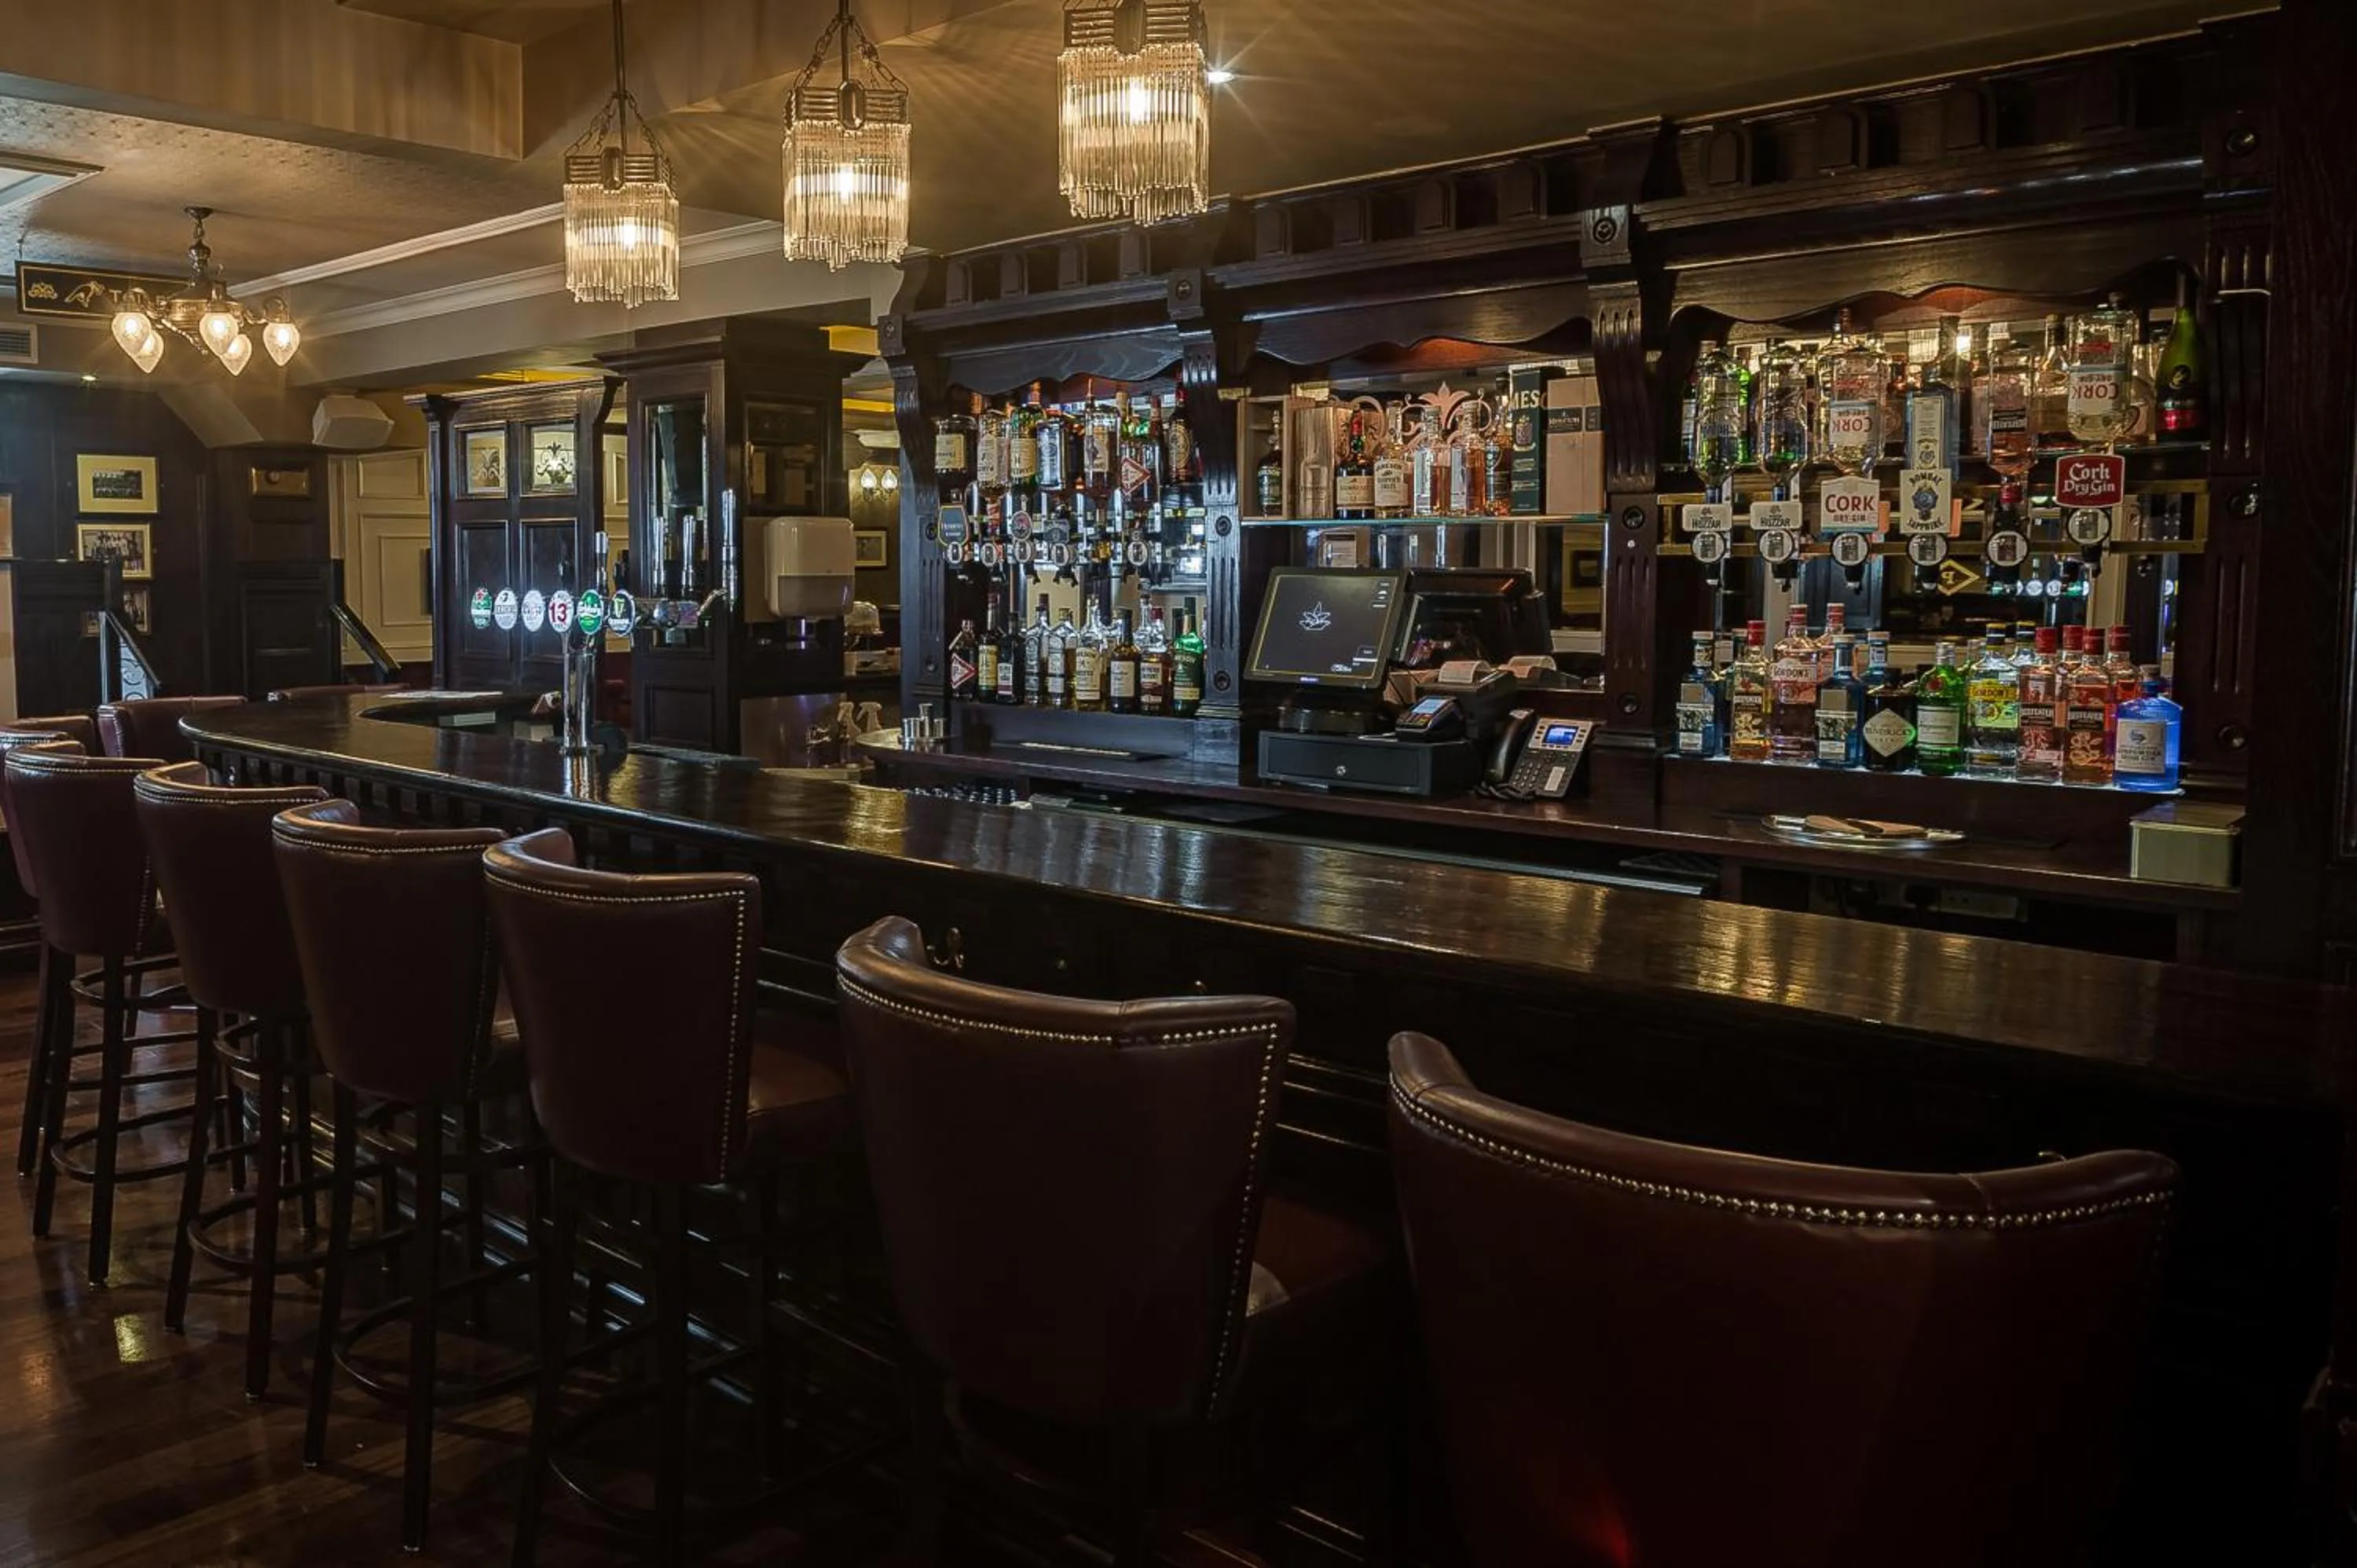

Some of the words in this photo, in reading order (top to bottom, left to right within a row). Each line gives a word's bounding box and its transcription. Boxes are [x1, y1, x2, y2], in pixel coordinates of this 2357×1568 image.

[2070, 383, 2119, 400] CORK
[1832, 416, 1874, 432] CORK
[2069, 462, 2110, 482] Cork
[2062, 480, 2089, 496] Dry
[2090, 481, 2116, 496] Gin
[1825, 494, 1875, 513] CORK
[550, 603, 567, 623] 13
